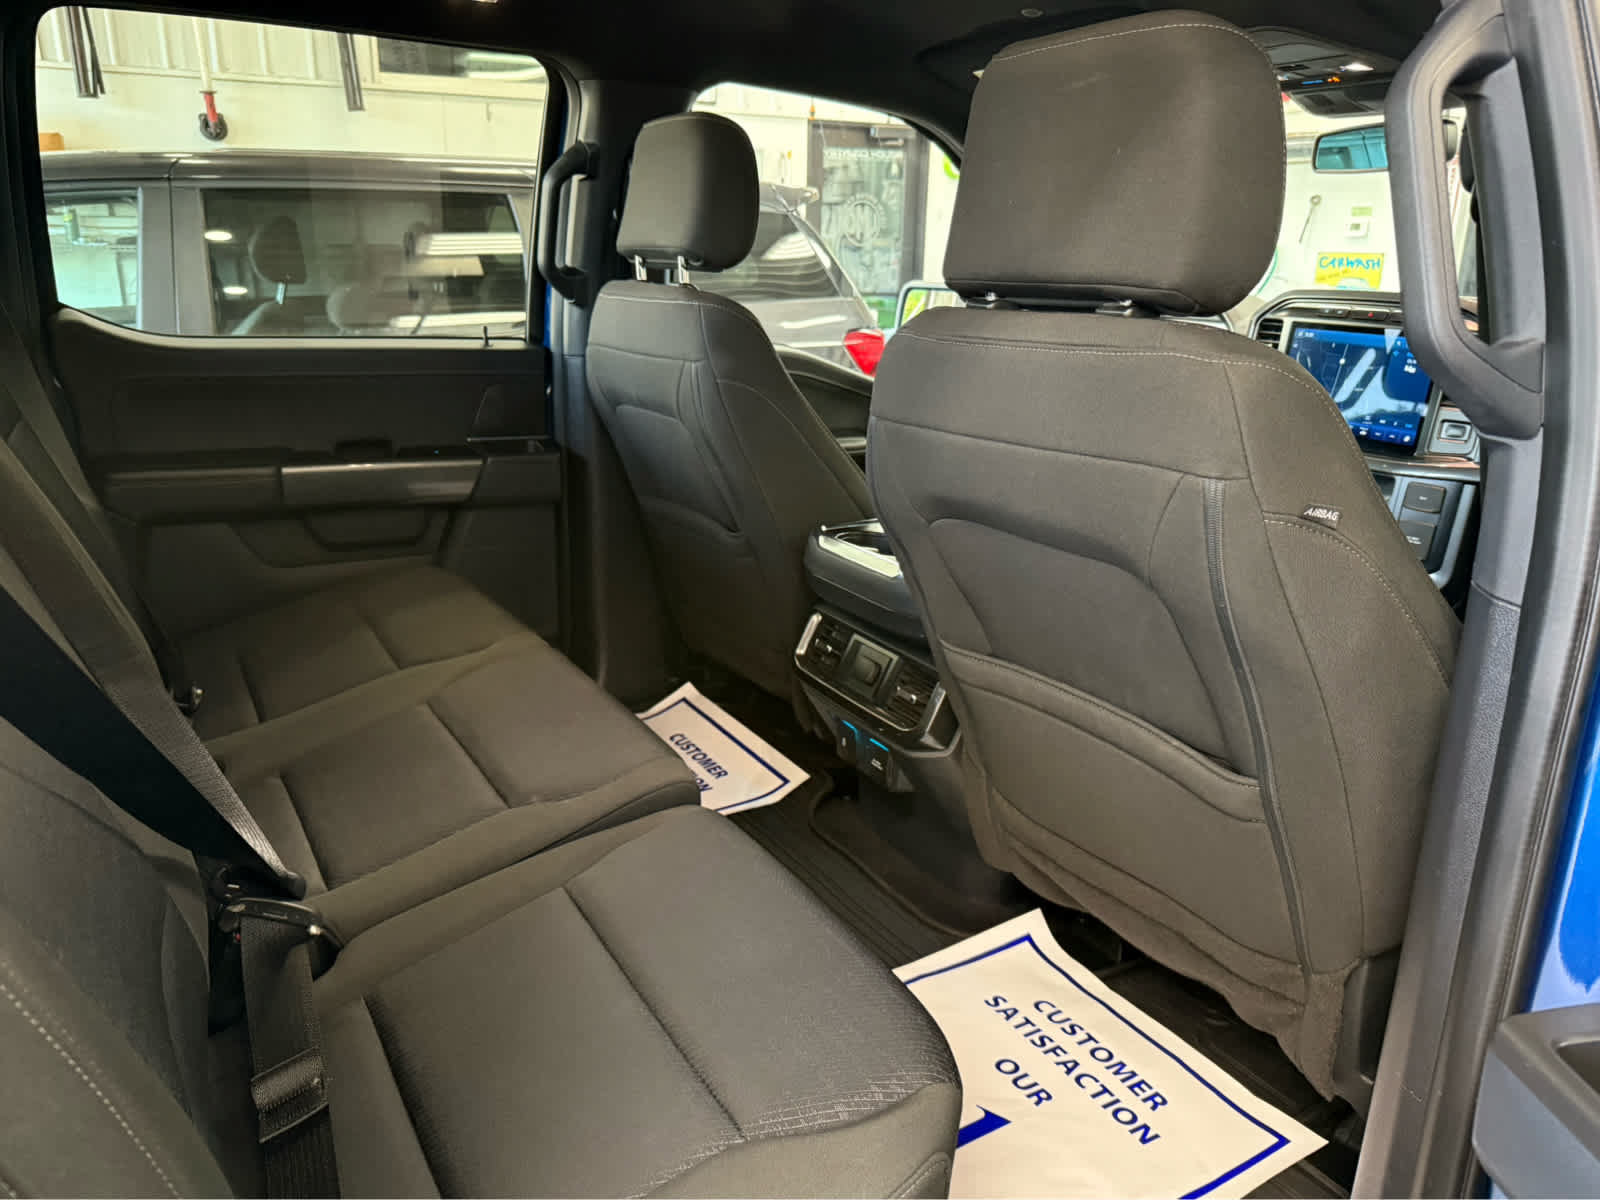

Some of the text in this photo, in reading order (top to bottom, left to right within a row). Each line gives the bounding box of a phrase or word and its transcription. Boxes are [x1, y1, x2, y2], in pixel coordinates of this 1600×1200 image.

[1303, 507, 1341, 520] AIRBAG
[669, 733, 728, 779] CUSTOMER
[984, 995, 1160, 1145] SATISFACTION
[1033, 1000, 1168, 1111] CUSTOMER
[994, 1058, 1053, 1106] OUR
